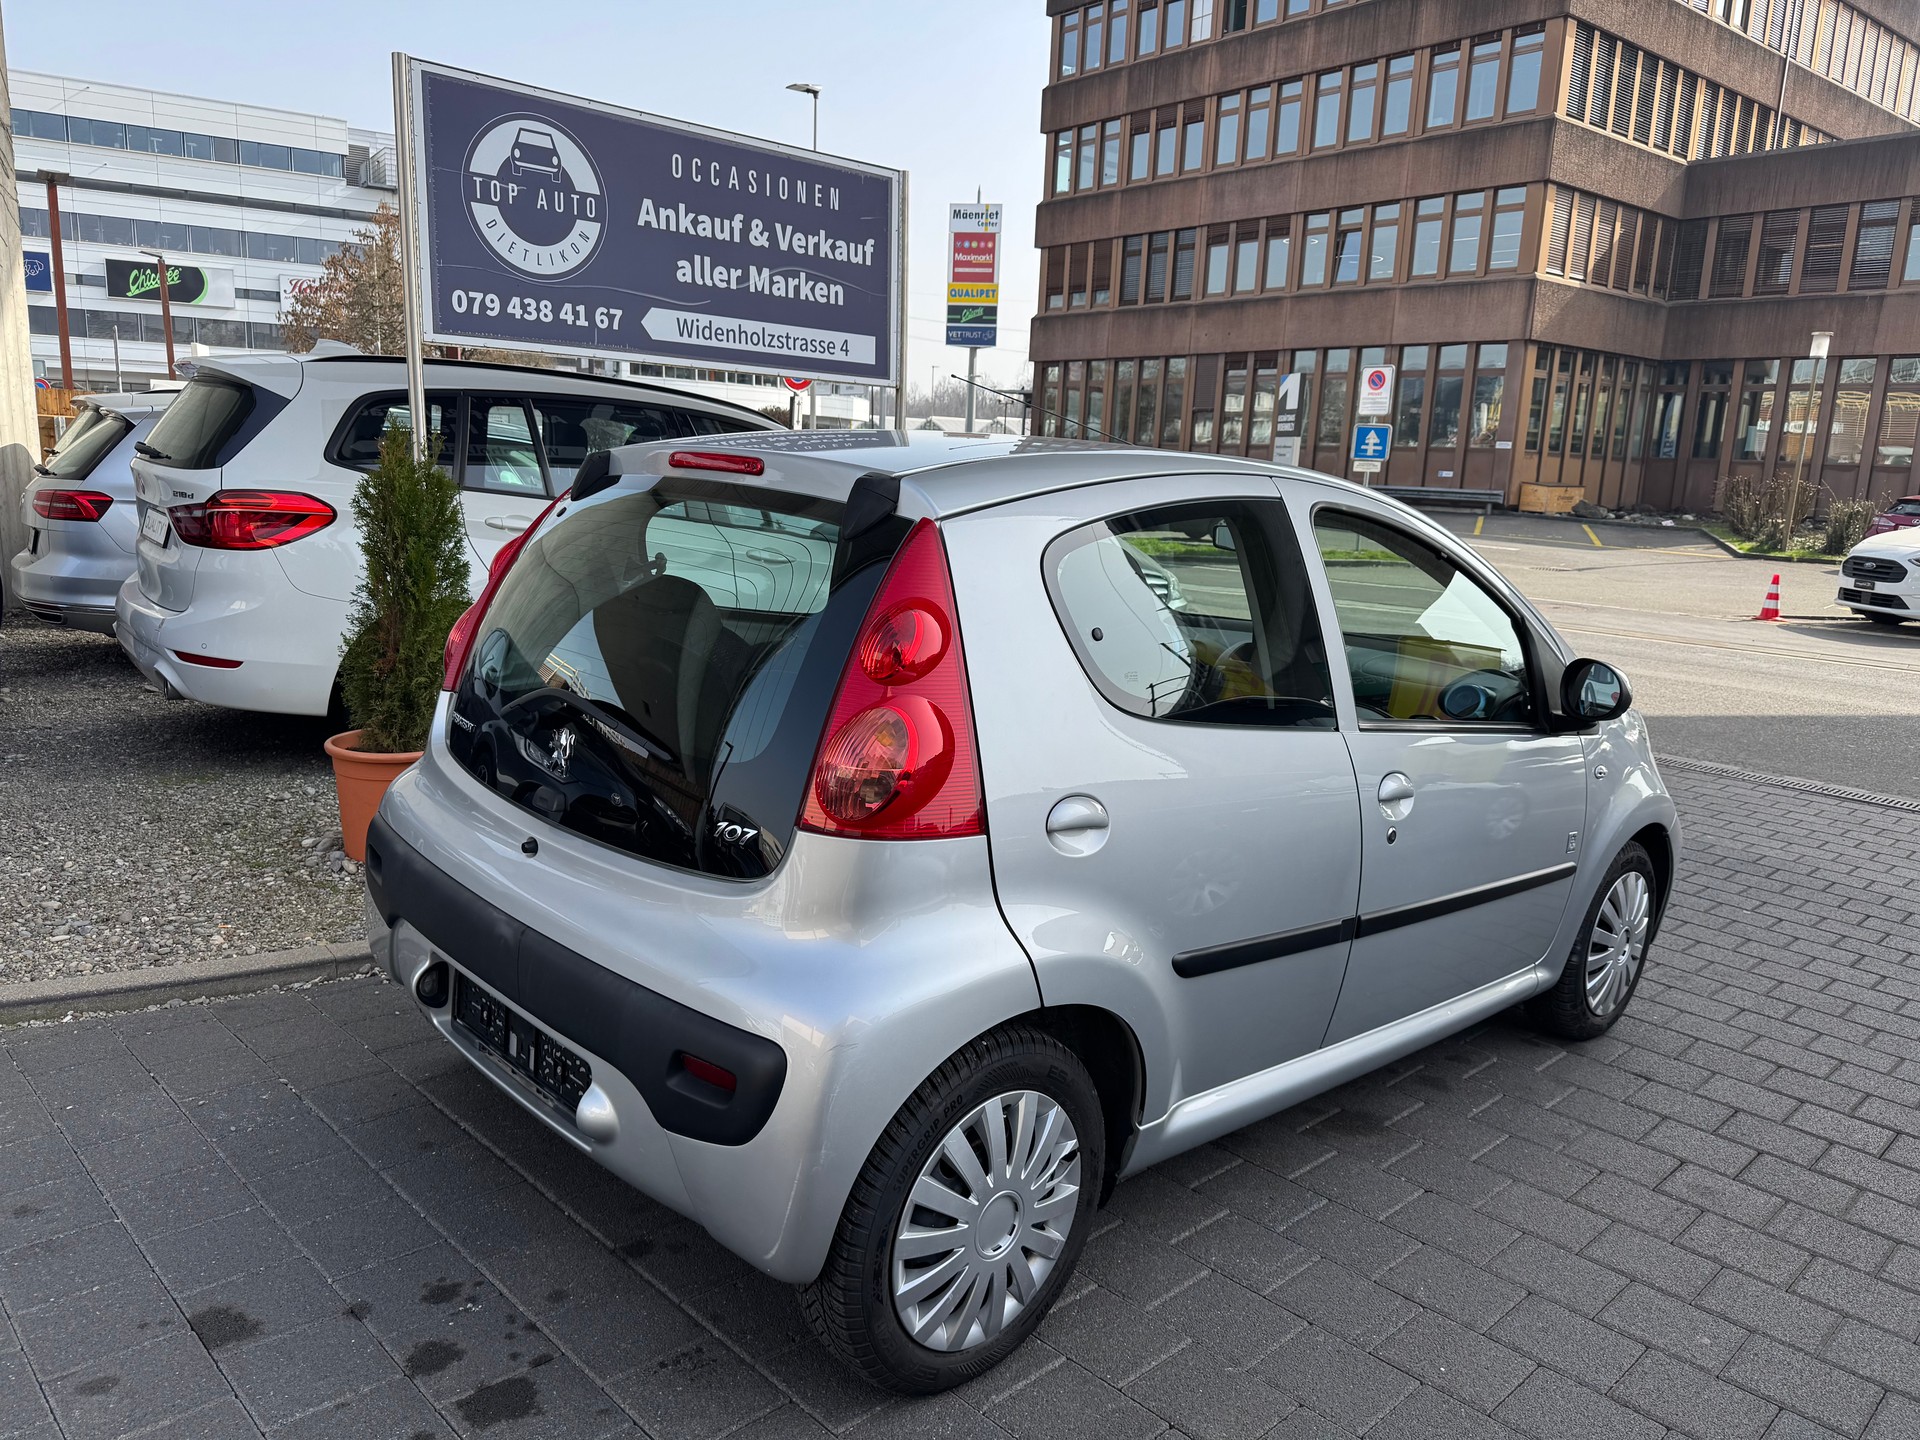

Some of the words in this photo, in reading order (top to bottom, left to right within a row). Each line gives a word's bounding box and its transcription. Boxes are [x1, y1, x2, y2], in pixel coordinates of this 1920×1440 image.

[472, 176, 519, 205] TOP
[536, 188, 596, 219] AUTO
[671, 152, 841, 212] OCCASIONEN
[637, 197, 743, 245] Ankauf
[748, 218, 769, 248] &
[774, 222, 875, 268] Verkauf
[952, 208, 999, 221] Mäenriet
[977, 220, 998, 228] Center
[484, 217, 591, 268] DIETLIKON
[954, 252, 993, 263] Maximarkt
[675, 255, 742, 290] aller
[748, 264, 845, 306] Marken
[949, 288, 997, 299] QUALIPET
[451, 288, 502, 315] 079
[507, 296, 553, 323] 438
[559, 303, 589, 328] 41
[594, 308, 623, 331] 67
[675, 316, 836, 357] Widenholzstrasse
[839, 338, 851, 357] 4
[713, 821, 759, 847] 107
[893, 1118, 940, 1192] SUPERGRIP
[943, 1094, 963, 1118] PRO
